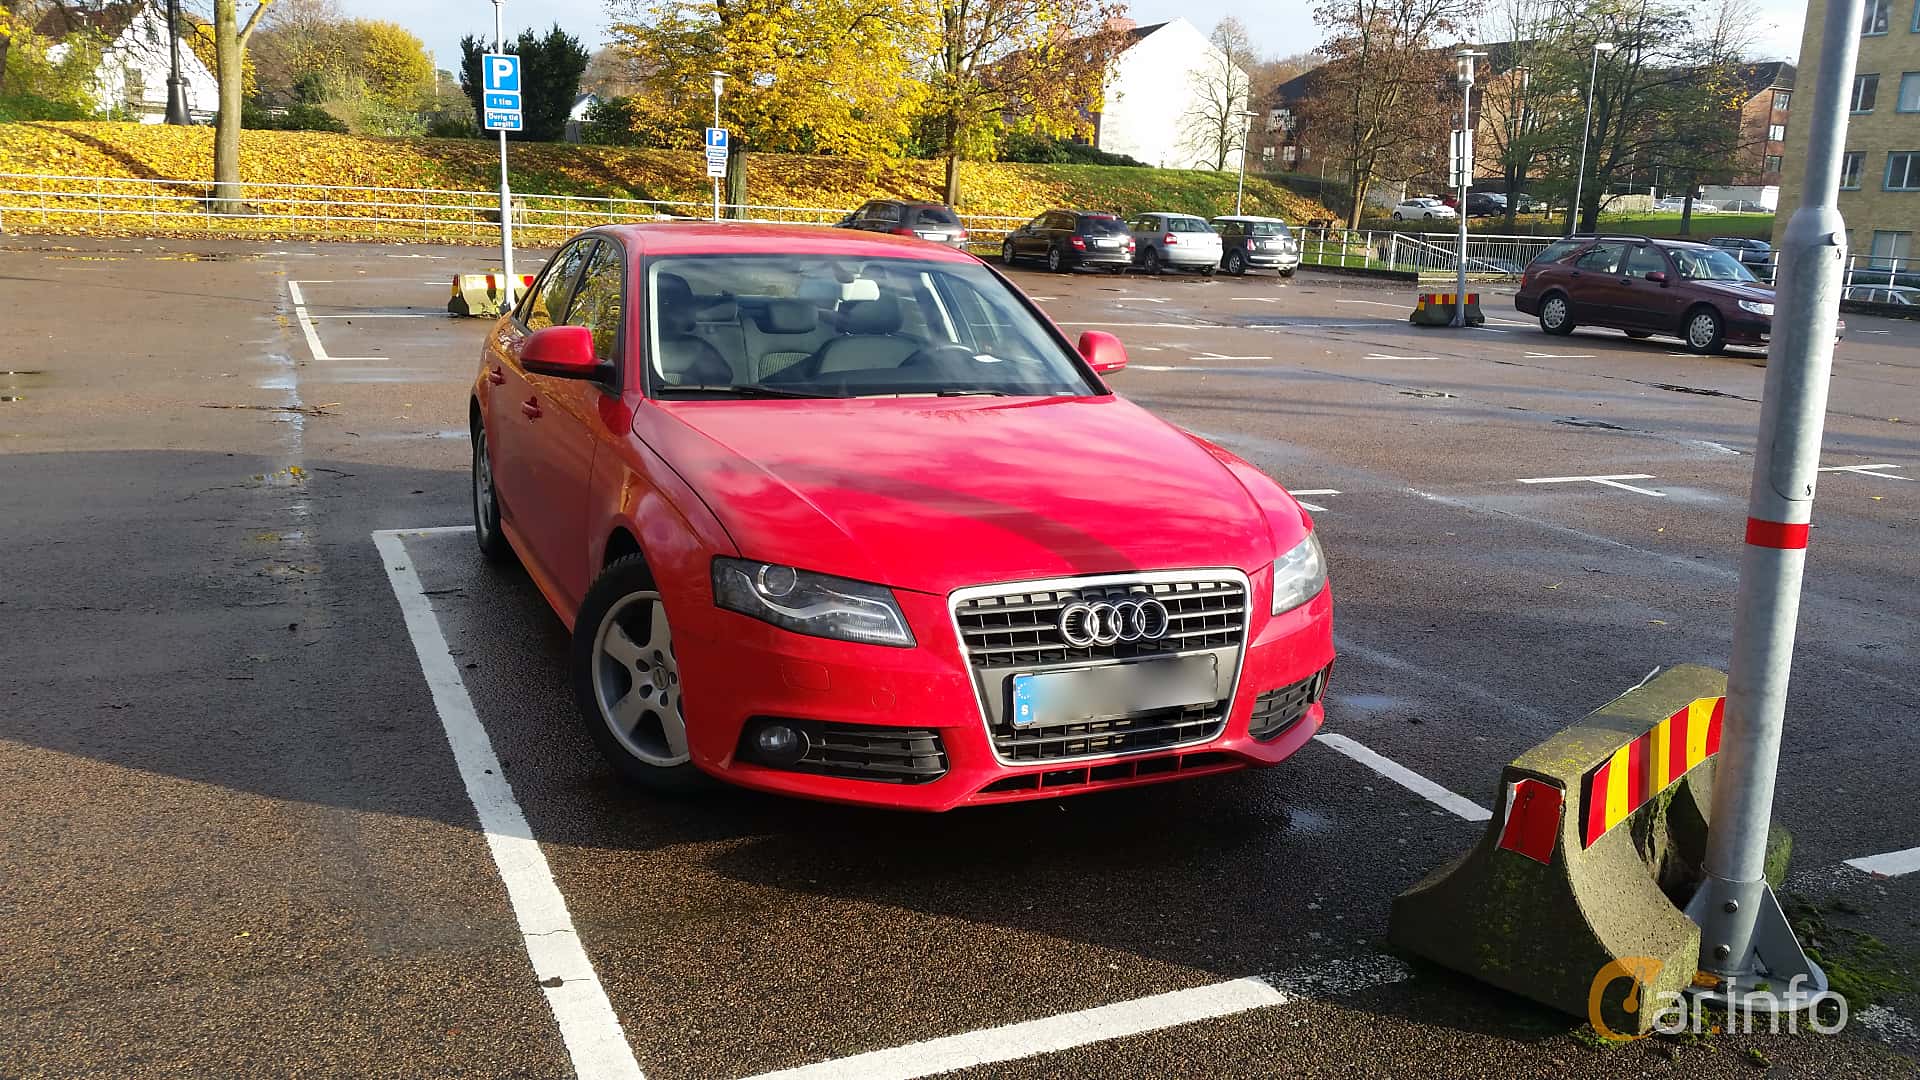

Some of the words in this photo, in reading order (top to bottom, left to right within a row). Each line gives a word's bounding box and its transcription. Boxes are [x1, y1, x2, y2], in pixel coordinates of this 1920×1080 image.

[493, 58, 513, 88] P
[712, 130, 724, 146] P
[1021, 704, 1029, 716] S
